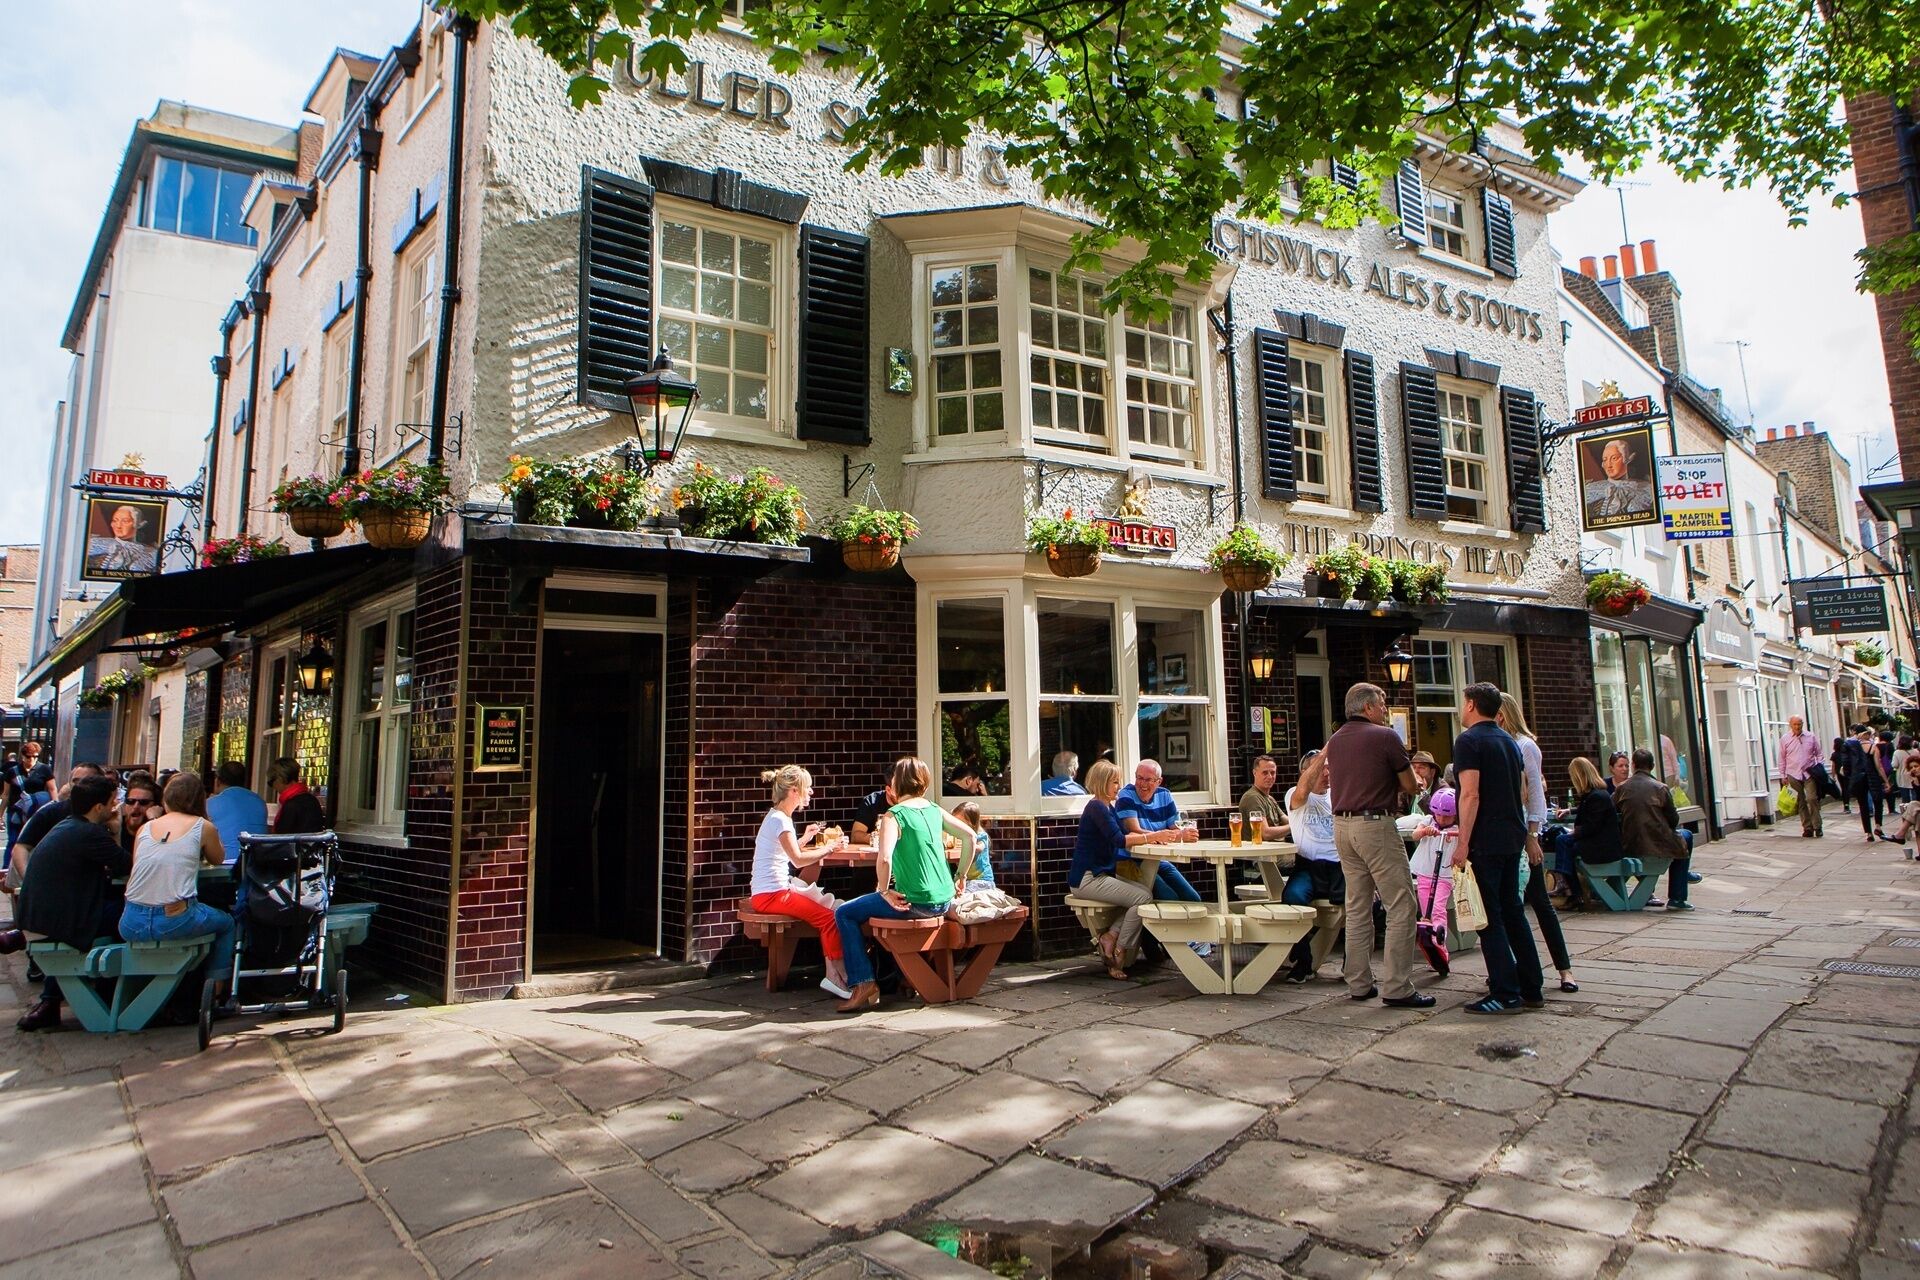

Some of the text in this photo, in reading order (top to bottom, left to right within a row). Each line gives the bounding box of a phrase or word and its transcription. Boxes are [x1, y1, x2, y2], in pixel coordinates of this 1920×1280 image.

[1213, 219, 1543, 340] CHISWICK ALES & STOUTS
[1683, 457, 1722, 465] RELOCATION
[94, 472, 163, 489] FULLER'S
[1663, 482, 1723, 500] TO LET
[1633, 512, 1650, 520] HEAD
[1679, 512, 1714, 520] MARTIN
[1674, 519, 1721, 528] CAMPBELL
[1111, 525, 1172, 547] ULLER'S
[1285, 522, 1338, 554] THE
[1463, 545, 1524, 578] HEAD
[1812, 592, 1880, 602] mary's living
[1823, 607, 1856, 616] giving
[1860, 605, 1881, 613] shop
